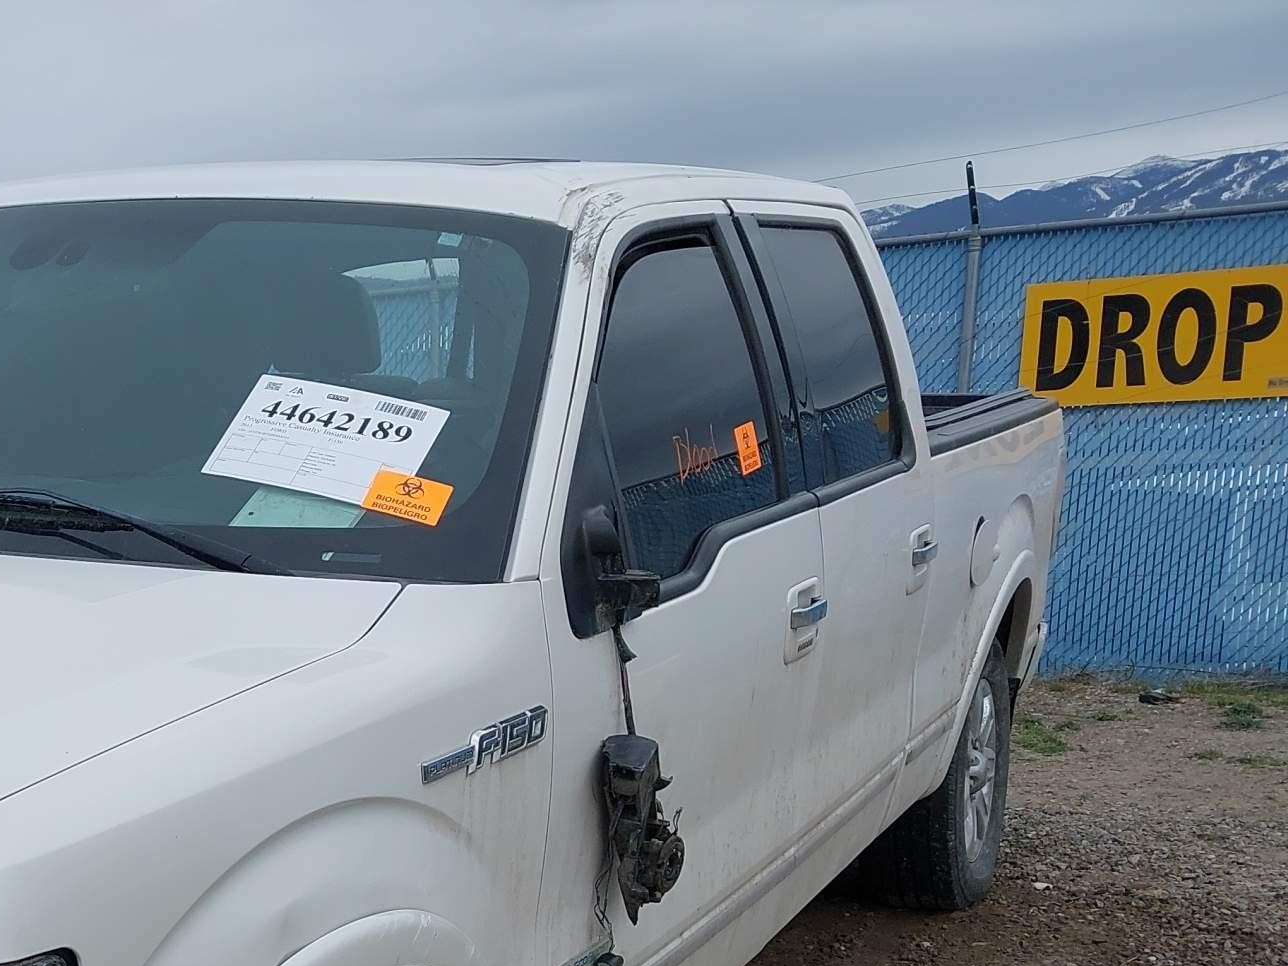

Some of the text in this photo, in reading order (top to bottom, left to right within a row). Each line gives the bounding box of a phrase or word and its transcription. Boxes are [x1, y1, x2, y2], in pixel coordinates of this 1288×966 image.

[1035, 284, 1283, 392] DROP
[261, 400, 413, 443] 44642189
[322, 428, 361, 442] Insurance
[371, 501, 428, 521] BIOPELIGRO
[375, 494, 431, 513] BIOHAZARD
